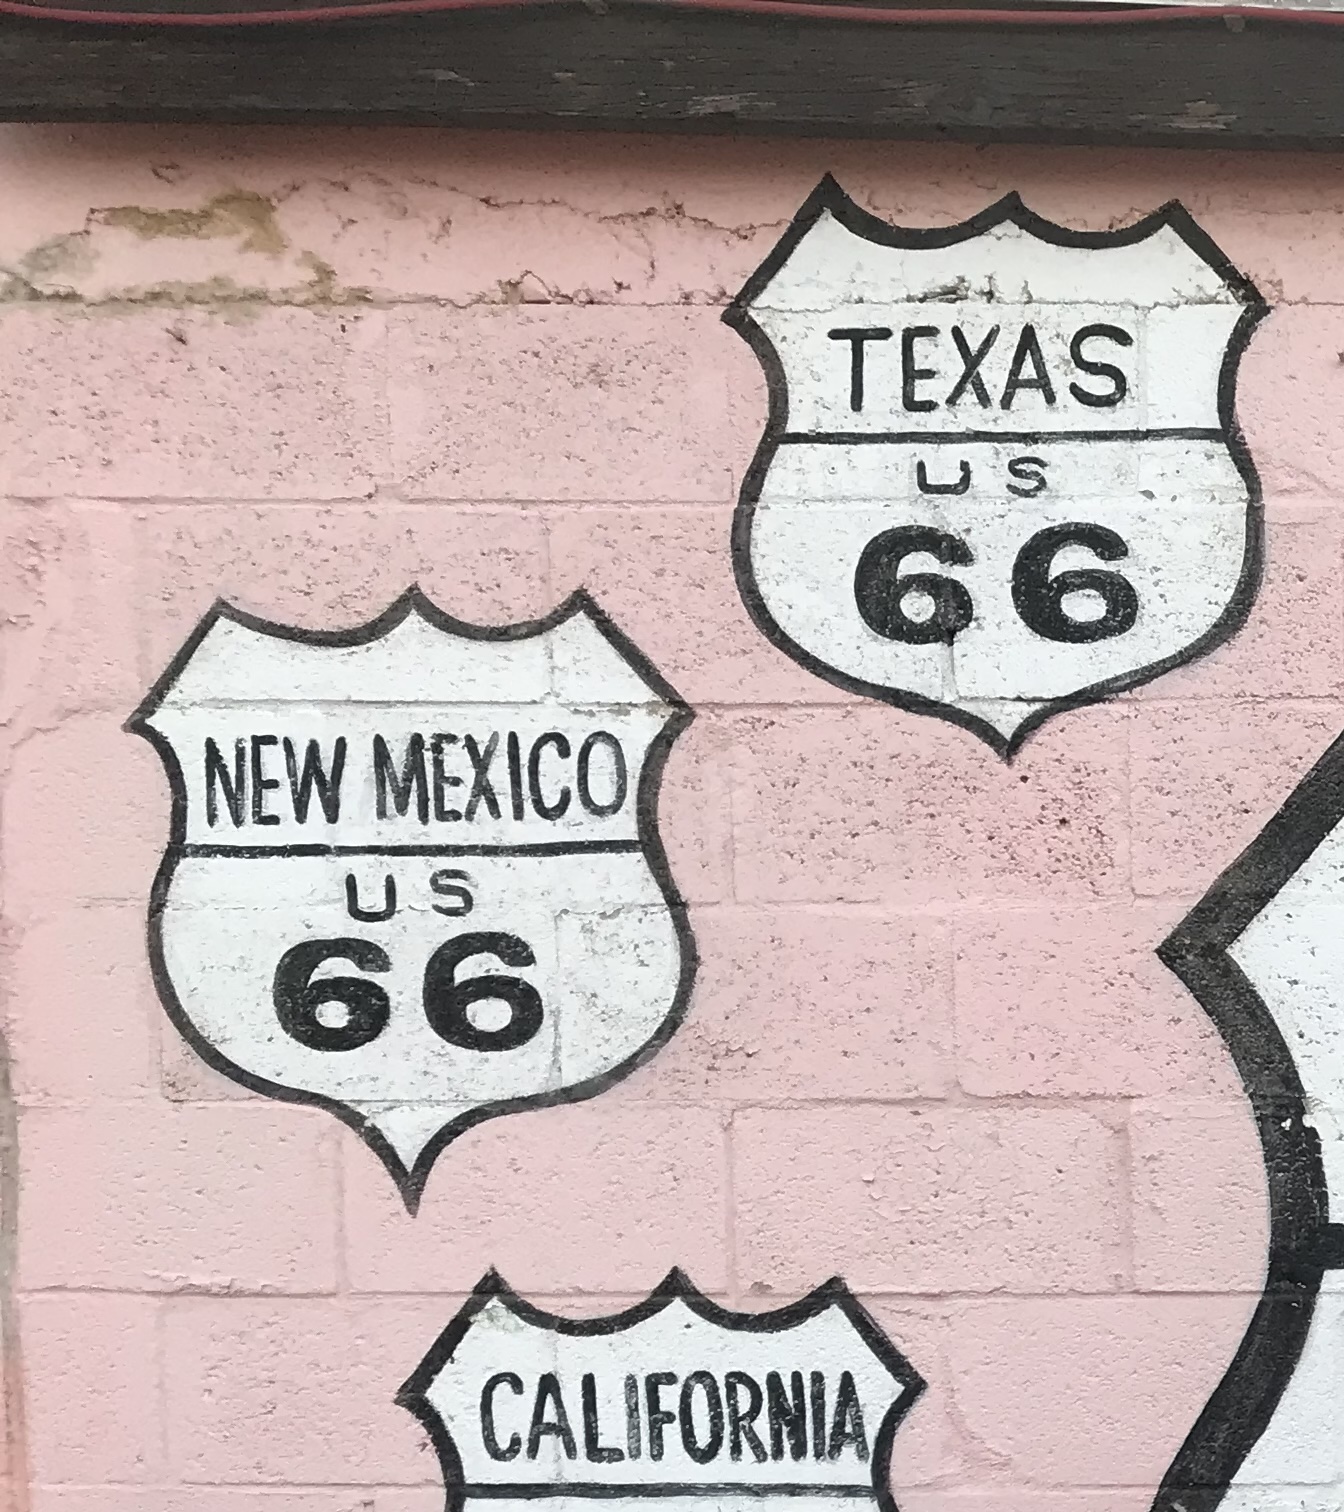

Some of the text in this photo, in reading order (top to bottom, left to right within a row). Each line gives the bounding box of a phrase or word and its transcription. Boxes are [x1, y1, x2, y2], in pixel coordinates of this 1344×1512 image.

[828, 323, 1133, 412] TEXAS
[854, 522, 1140, 645] 66
[204, 730, 628, 828] NEW MEXICO
[272, 931, 544, 1052] 66
[479, 1370, 871, 1463] CALIFORNIA
